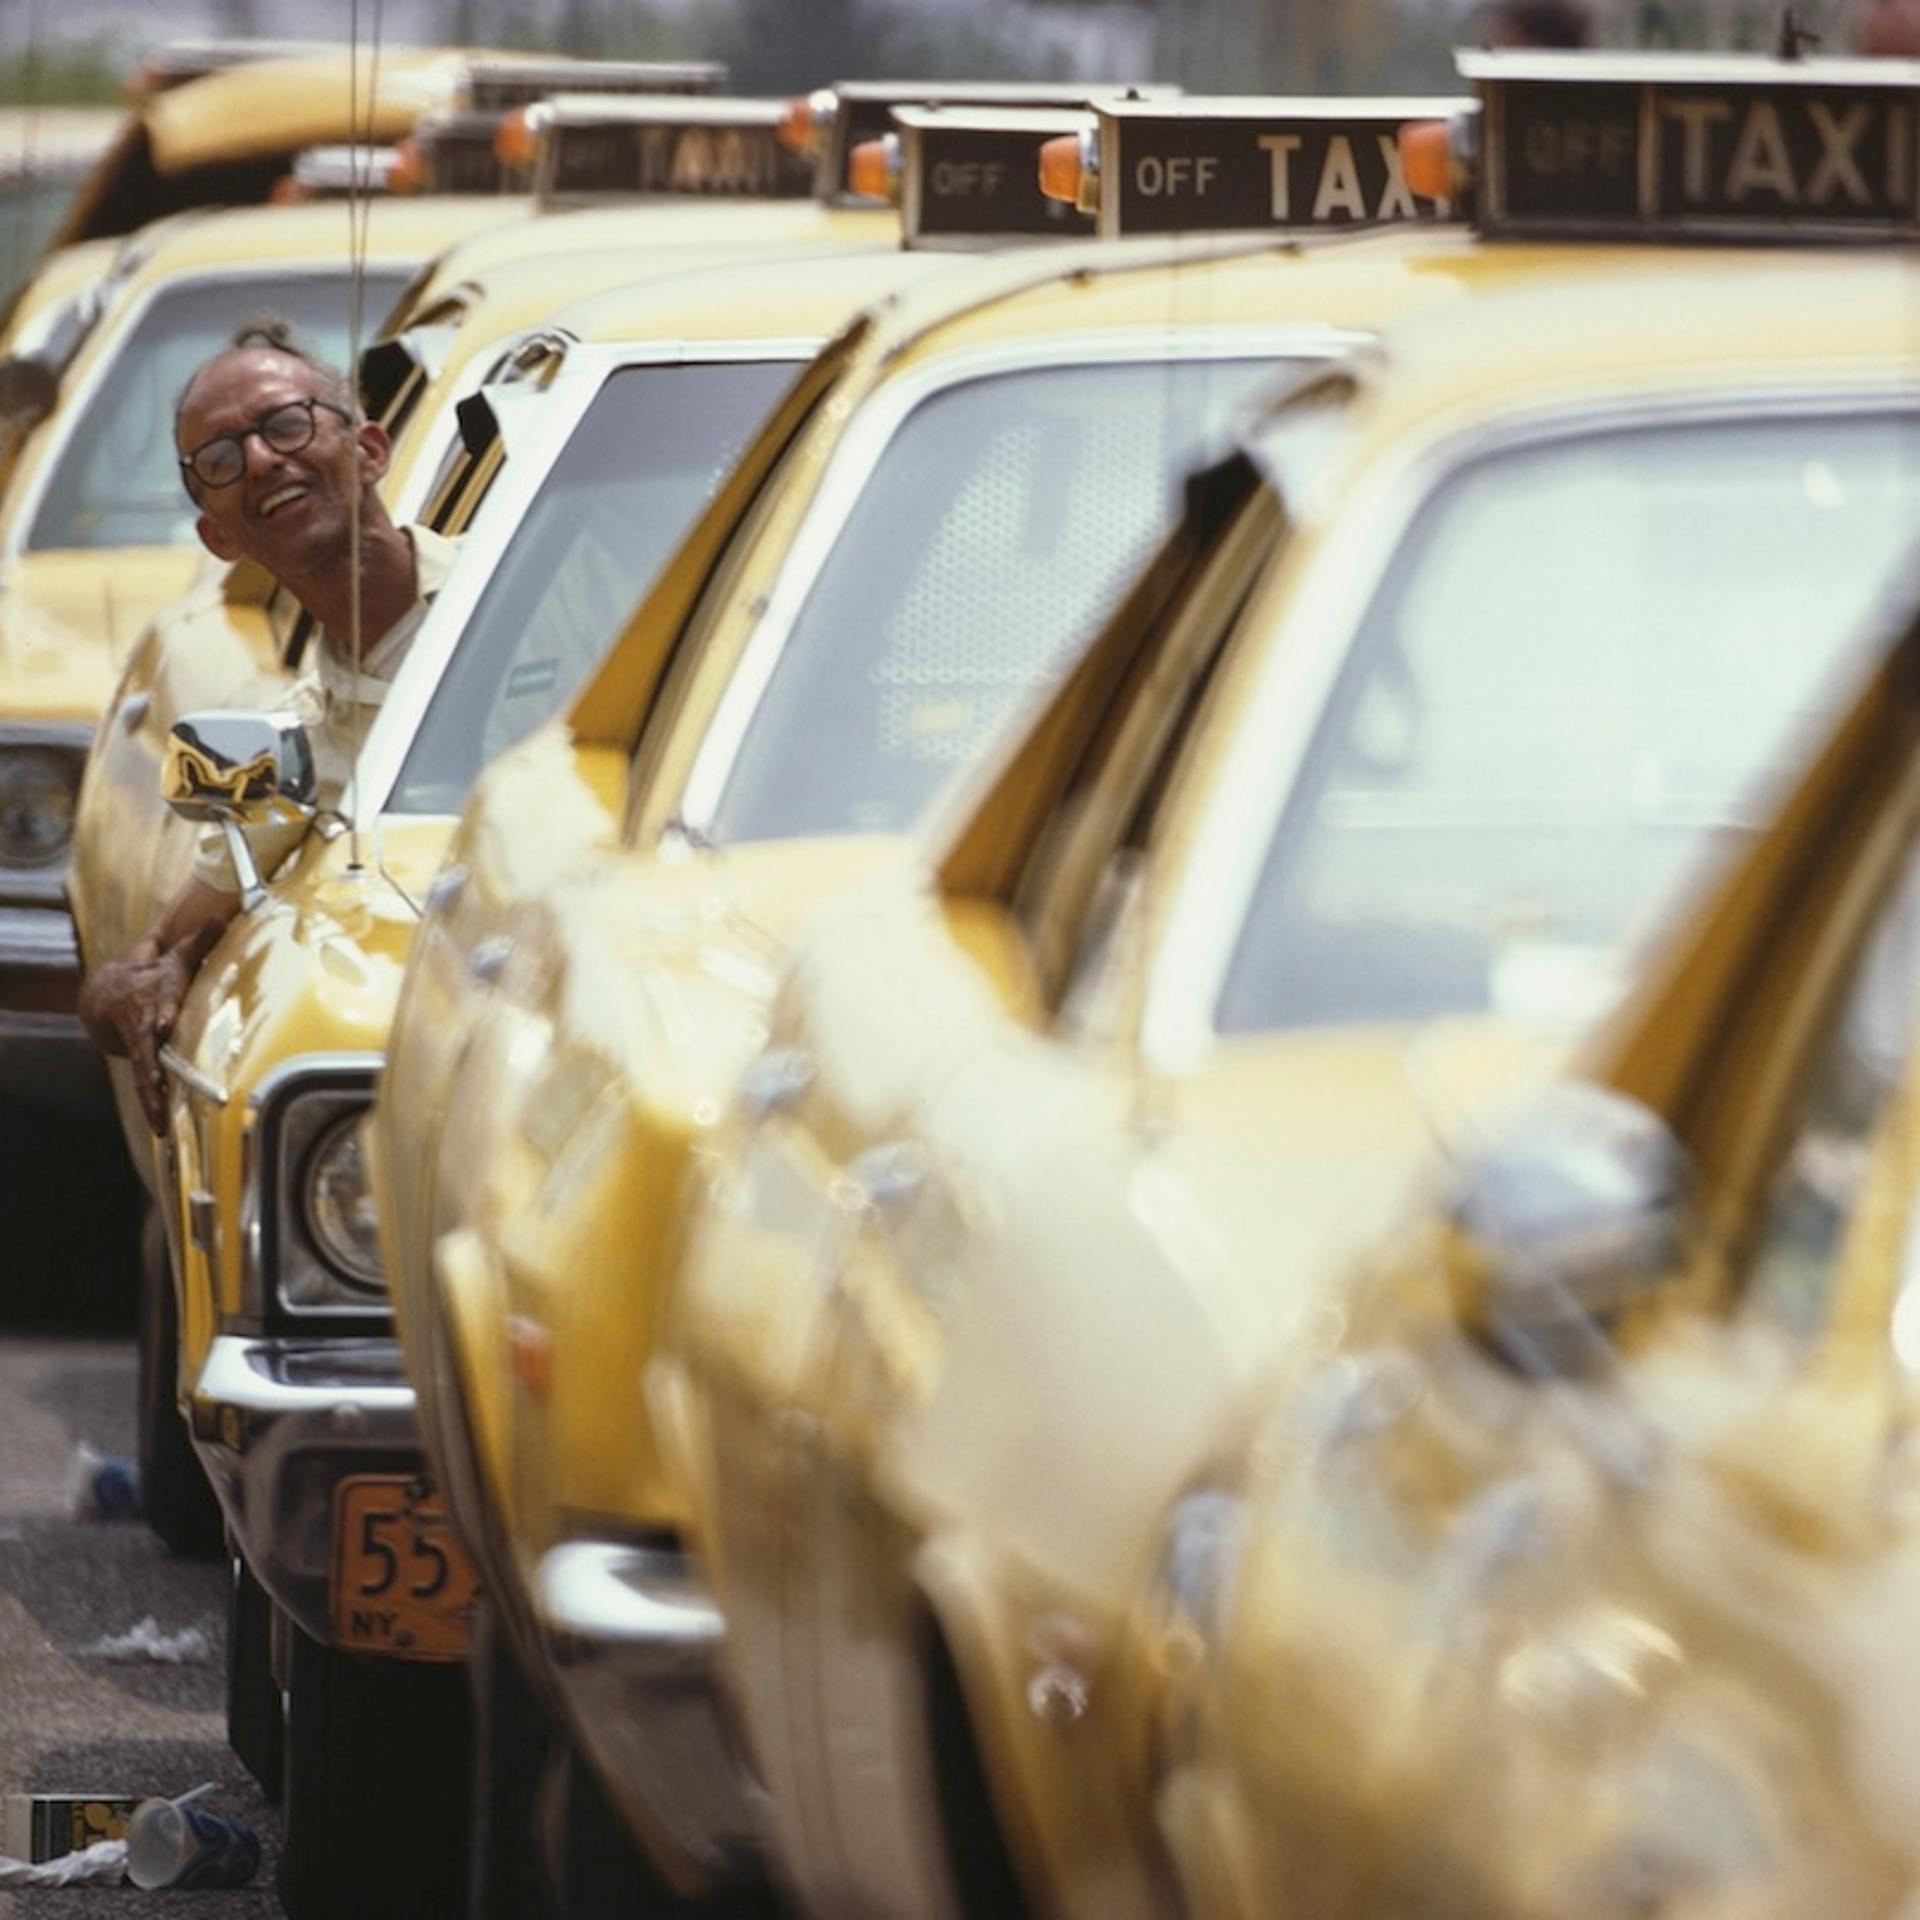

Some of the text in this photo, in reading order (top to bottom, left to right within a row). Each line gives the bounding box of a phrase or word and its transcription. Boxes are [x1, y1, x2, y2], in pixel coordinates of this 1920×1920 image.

[1524, 100, 1914, 205] OFF TAXI
[931, 162, 1004, 196] OFF
[1136, 156, 1219, 196] OFF
[360, 1511, 480, 1599] 55
[351, 1610, 397, 1636] NY
